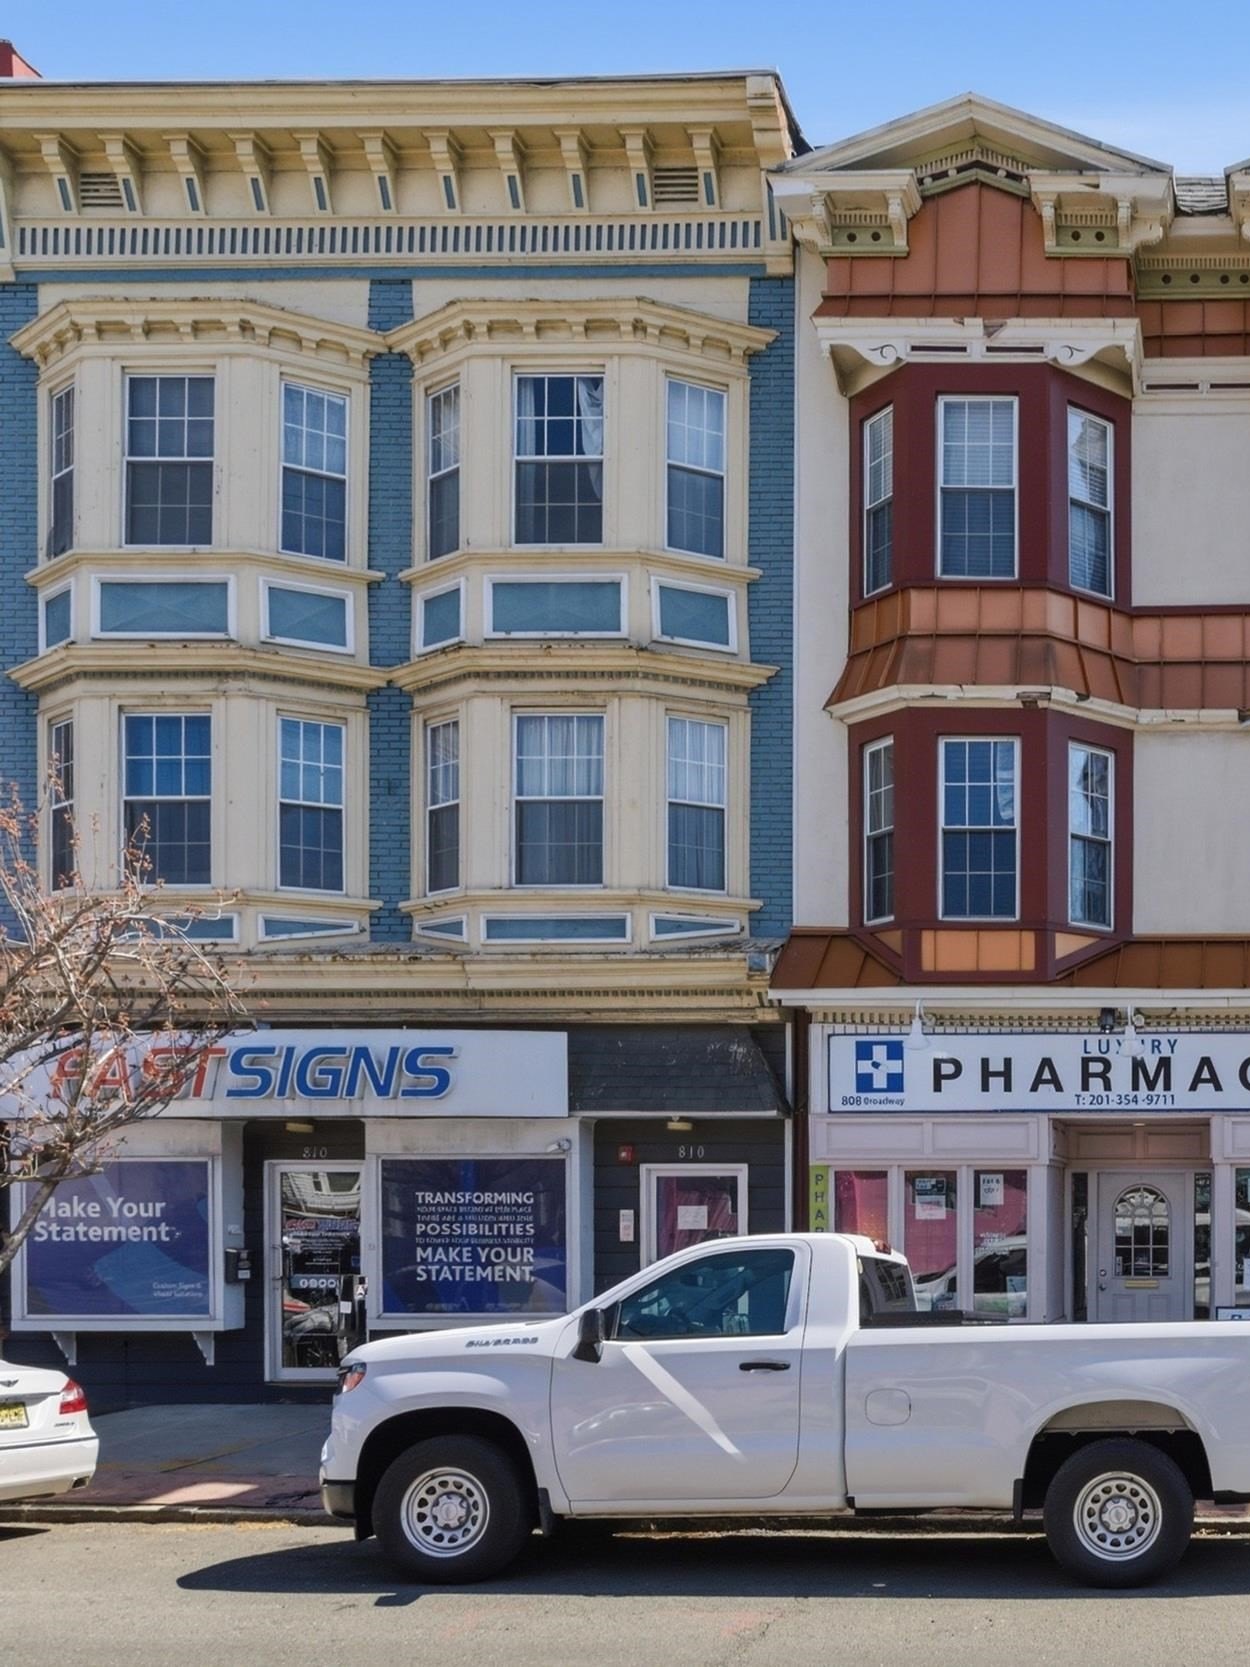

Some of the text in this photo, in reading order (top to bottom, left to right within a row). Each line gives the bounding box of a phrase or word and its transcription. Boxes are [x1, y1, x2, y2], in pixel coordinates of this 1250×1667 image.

[841, 1096, 861, 1106] 808
[303, 1147, 328, 1158] 810
[678, 1145, 705, 1158] 810
[415, 1192, 534, 1204] TRANSFORMING
[106, 1197, 167, 1218] Your
[33, 1221, 170, 1242] Statement
[416, 1223, 535, 1236] POSSIBILITIES
[416, 1247, 535, 1263] MAKE YOUR
[416, 1265, 535, 1282] STATEMENT.
